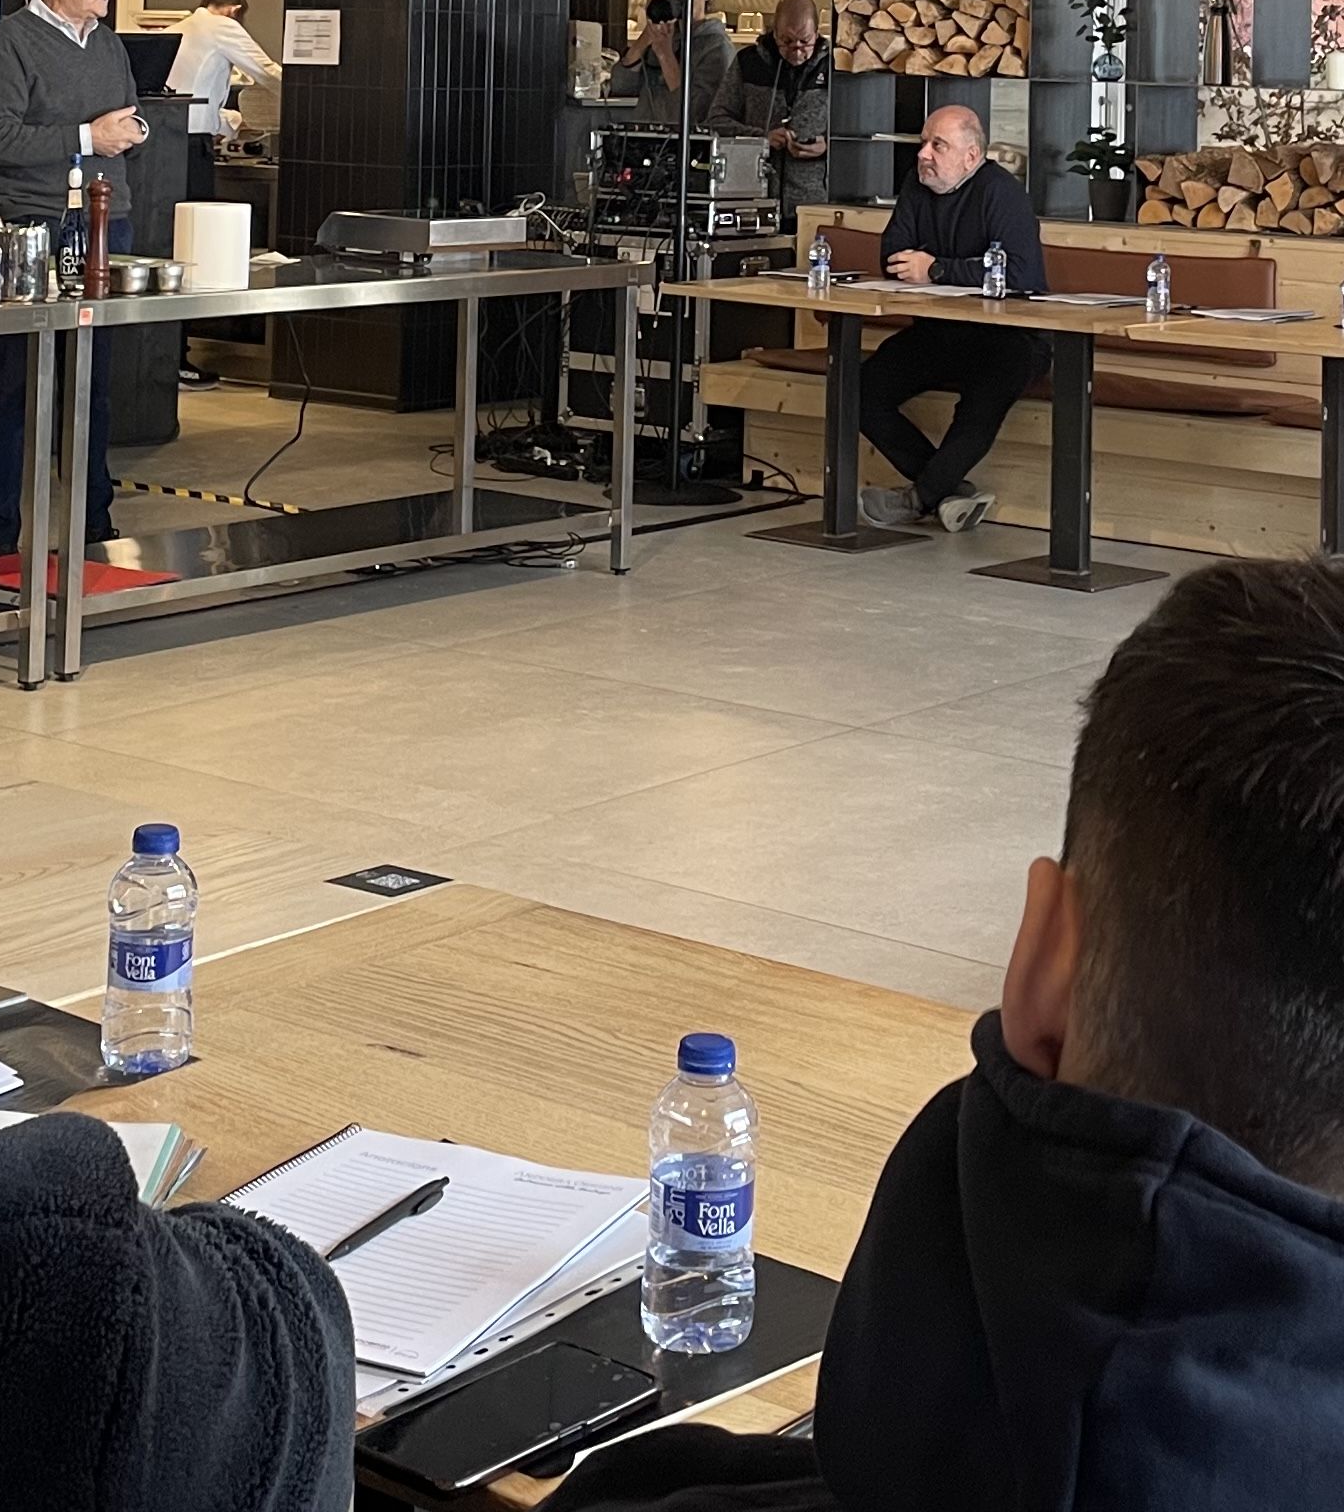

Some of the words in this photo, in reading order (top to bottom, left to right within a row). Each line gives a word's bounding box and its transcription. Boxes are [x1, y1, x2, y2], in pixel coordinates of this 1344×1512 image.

[62, 256, 86, 266] CUA
[125, 951, 156, 967] Font
[125, 966, 156, 980] Vella
[698, 1202, 735, 1219] Font
[697, 1217, 736, 1236] Vella
